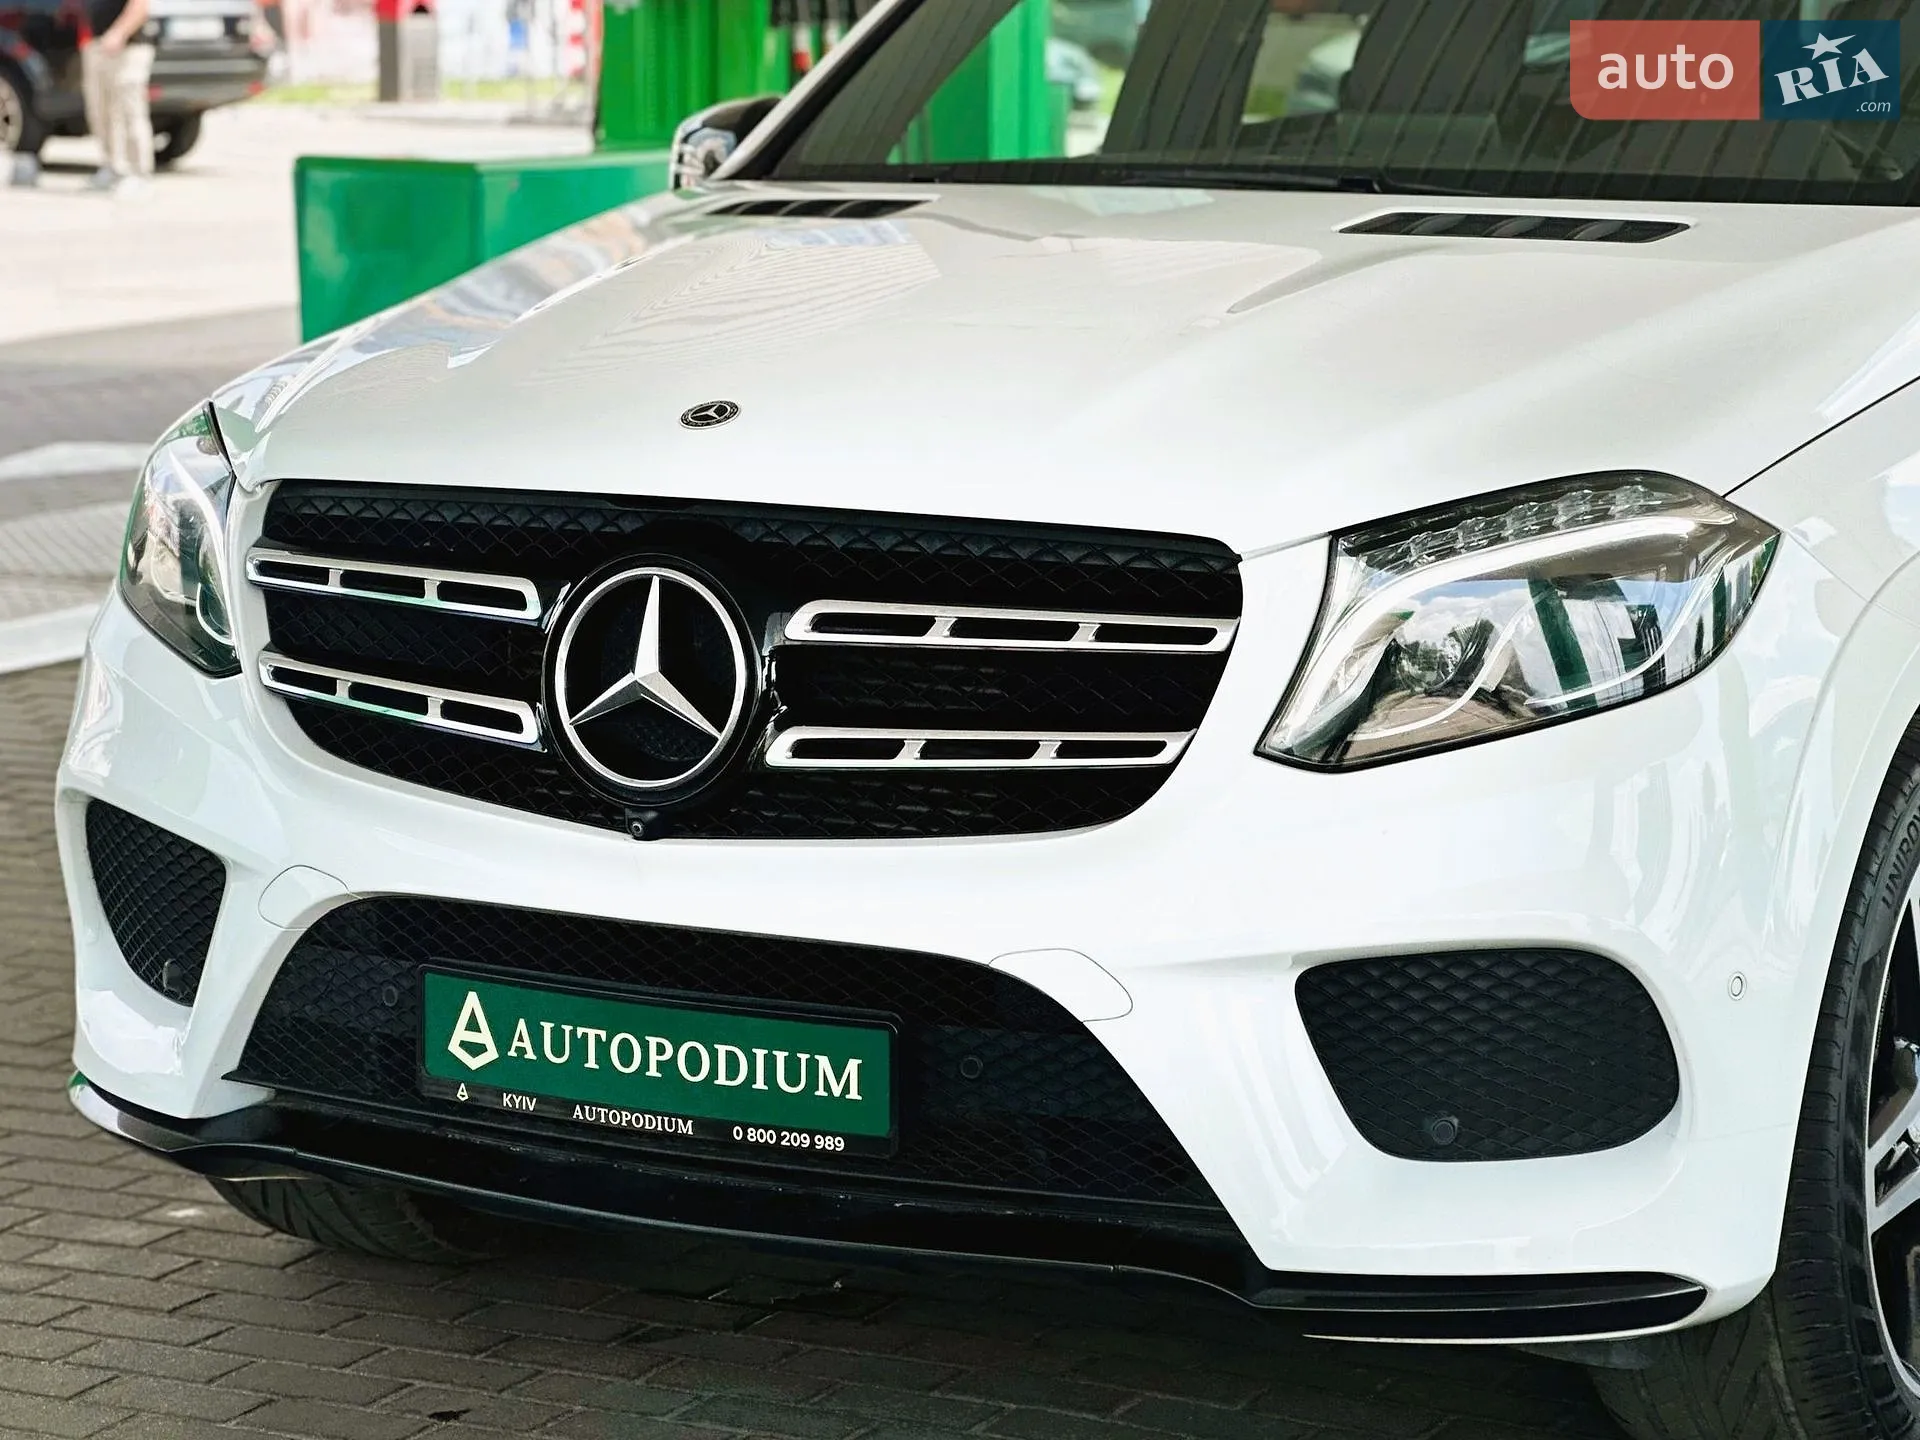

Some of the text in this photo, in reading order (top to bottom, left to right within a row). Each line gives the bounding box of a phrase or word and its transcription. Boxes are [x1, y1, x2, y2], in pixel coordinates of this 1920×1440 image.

[507, 1018, 863, 1101] AUTOPODIUM
[502, 1092, 845, 1152] KYIV AUTOPODIUM 0 800 209 989
